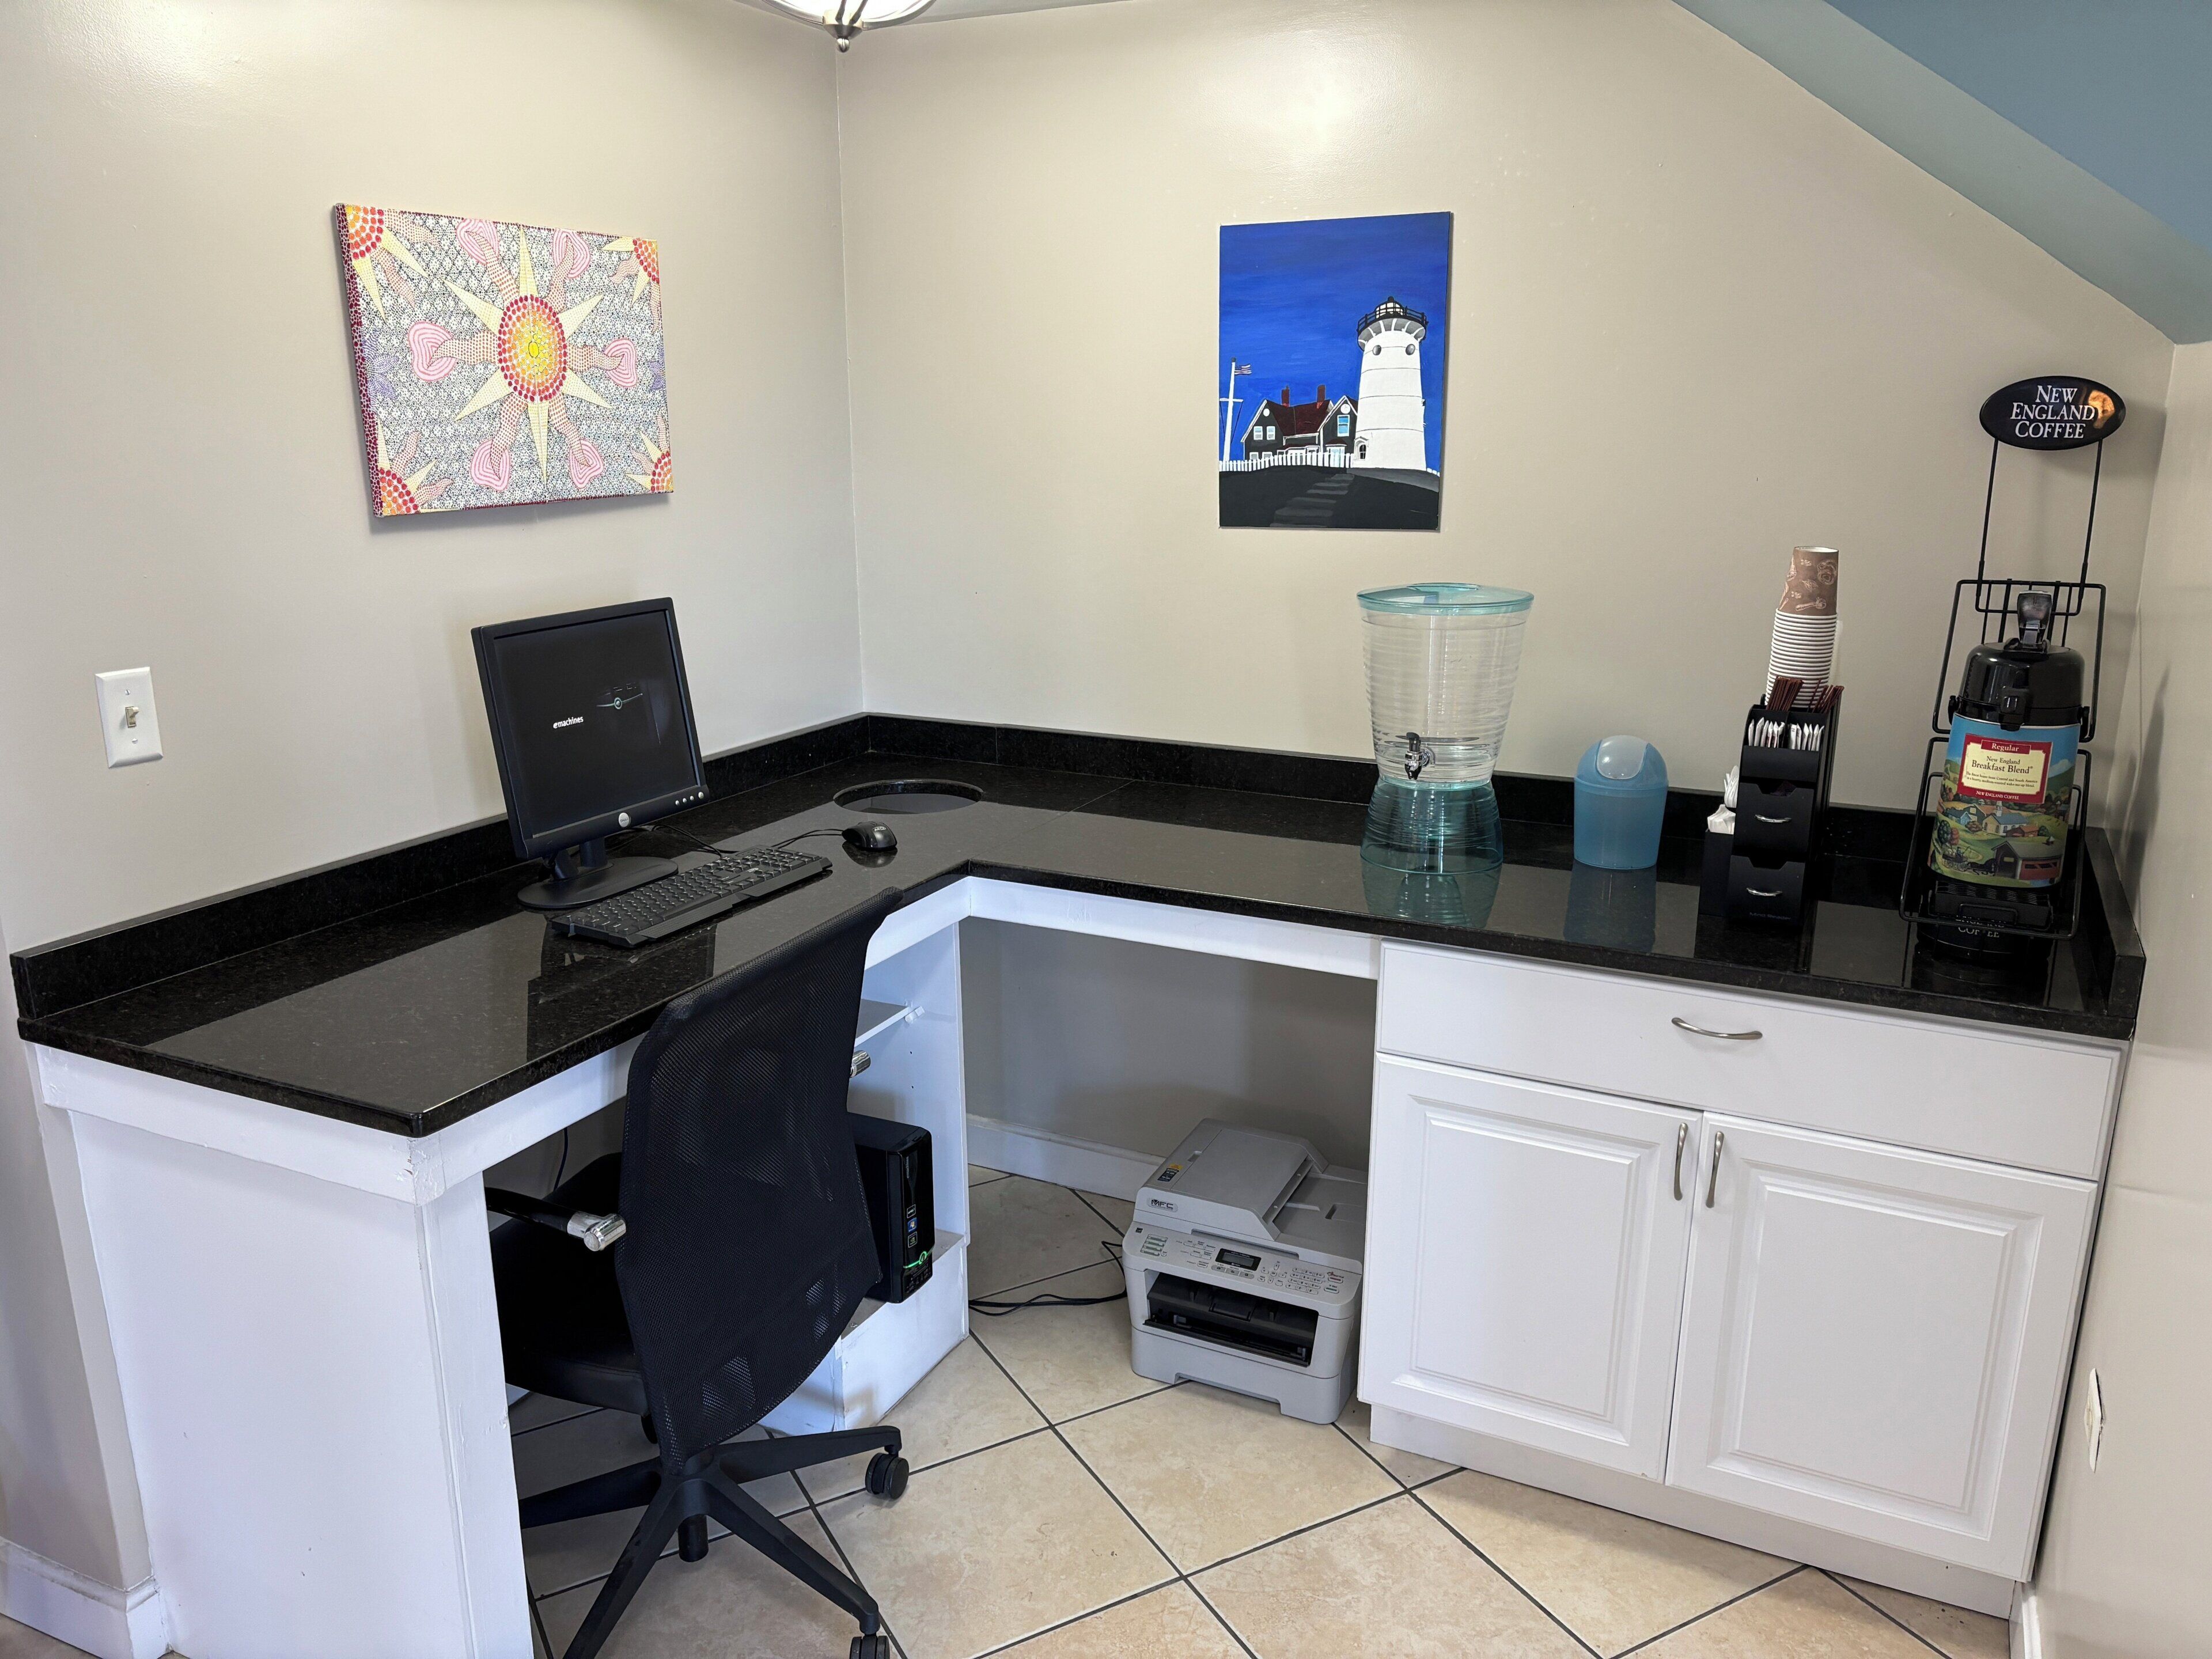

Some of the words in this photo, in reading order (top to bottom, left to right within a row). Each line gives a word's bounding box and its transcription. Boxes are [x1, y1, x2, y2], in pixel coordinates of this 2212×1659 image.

[2035, 385, 2077, 403] NEW
[2010, 402, 2095, 421] ENGLAND
[2015, 421, 2086, 439] COFFEE
[553, 716, 584, 729] emachines
[1991, 743, 2020, 752] Regular
[1972, 759, 2006, 772] Breakfast
[1151, 1199, 1174, 1209] MFC
